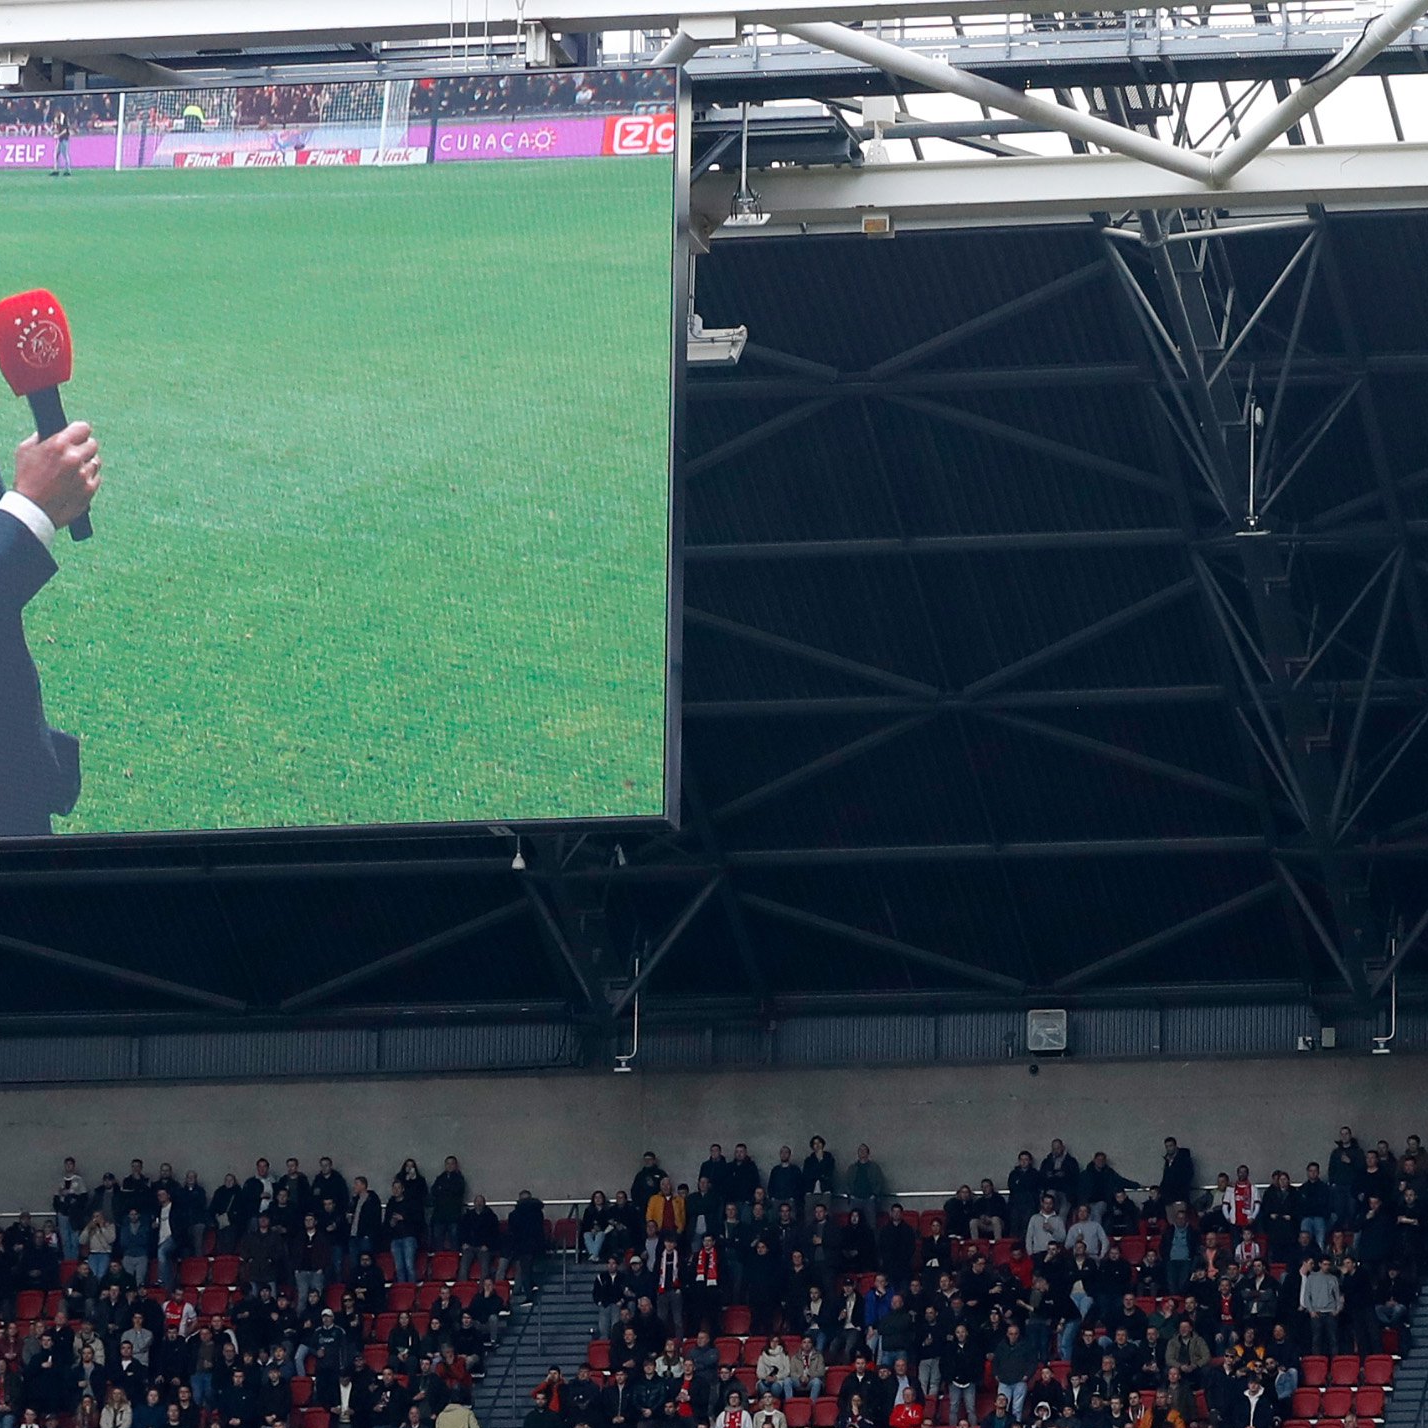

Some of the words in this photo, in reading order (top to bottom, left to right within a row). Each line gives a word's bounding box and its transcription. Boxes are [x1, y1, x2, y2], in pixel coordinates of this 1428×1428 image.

[4, 144, 45, 163] ZELF
[184, 152, 220, 166] Flink
[245, 152, 282, 166] Flink
[307, 150, 347, 165] Flink
